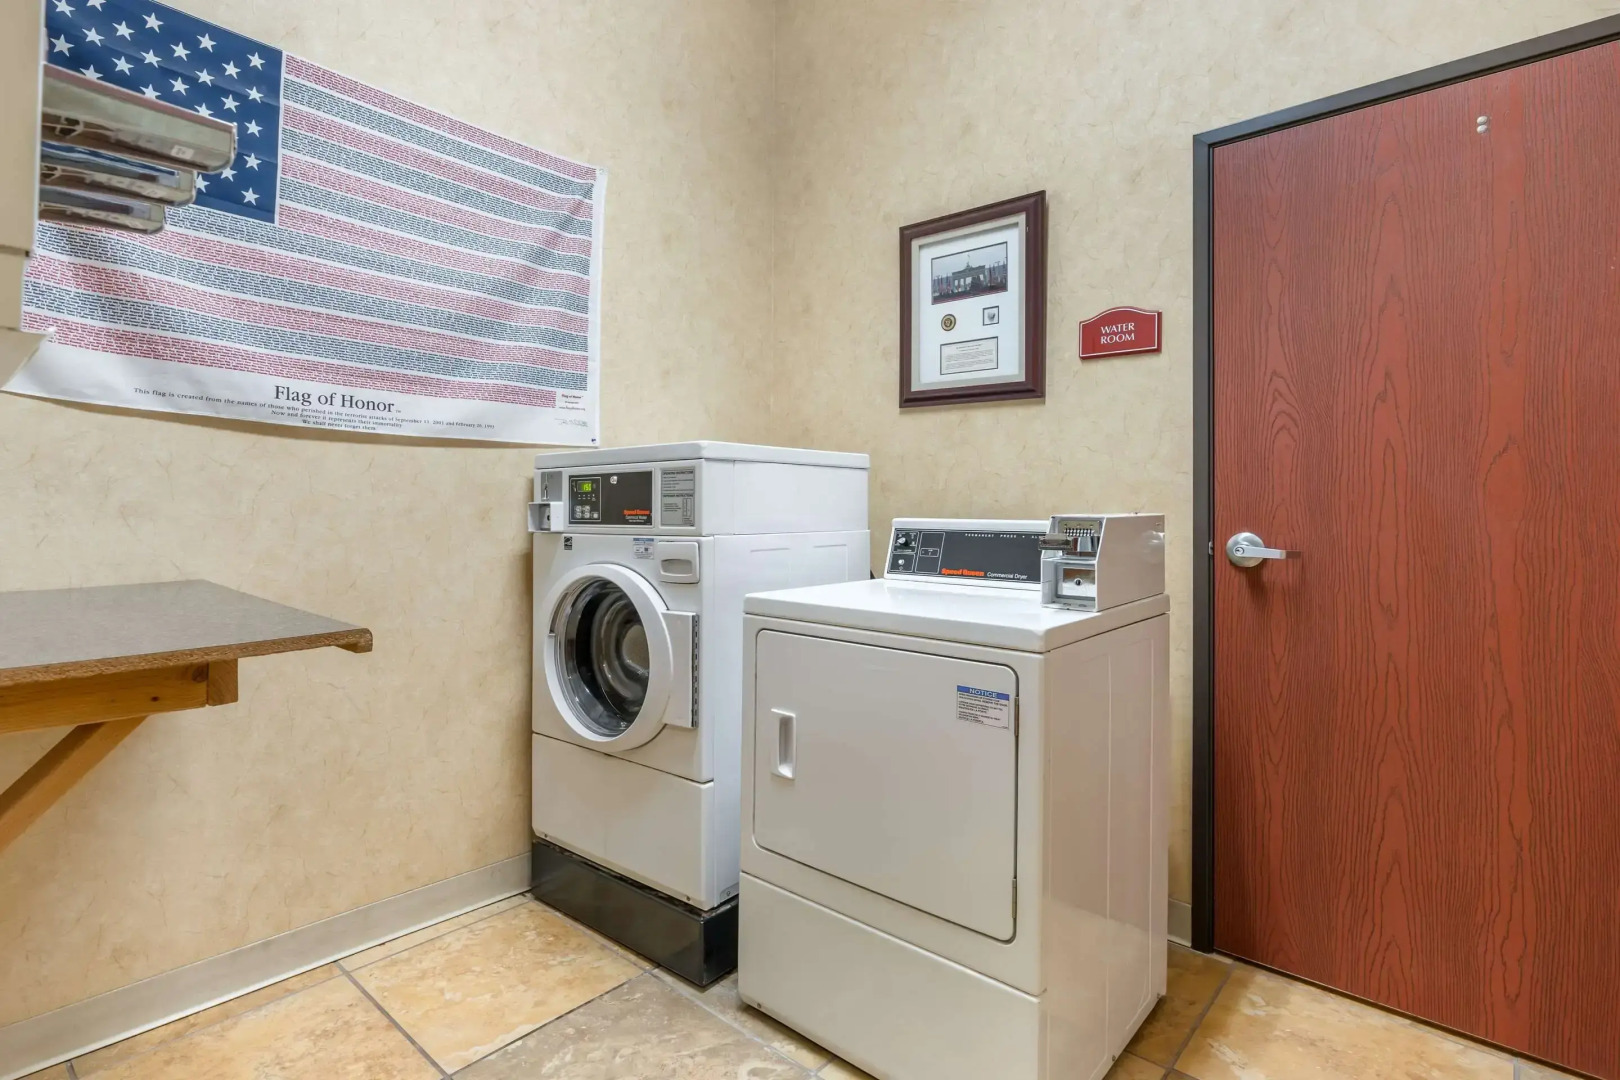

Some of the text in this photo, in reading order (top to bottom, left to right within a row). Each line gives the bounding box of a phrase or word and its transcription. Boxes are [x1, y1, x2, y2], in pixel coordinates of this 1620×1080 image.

[1100, 322, 1135, 334] WATER
[1100, 333, 1135, 344] ROOM
[134, 387, 150, 395] This
[177, 393, 204, 401] created
[301, 407, 326, 415] perished
[274, 385, 312, 406] Flag
[318, 393, 337, 406] of
[340, 394, 395, 413] Honor
[941, 568, 962, 576] Speed
[969, 688, 998, 698] NOTICE
